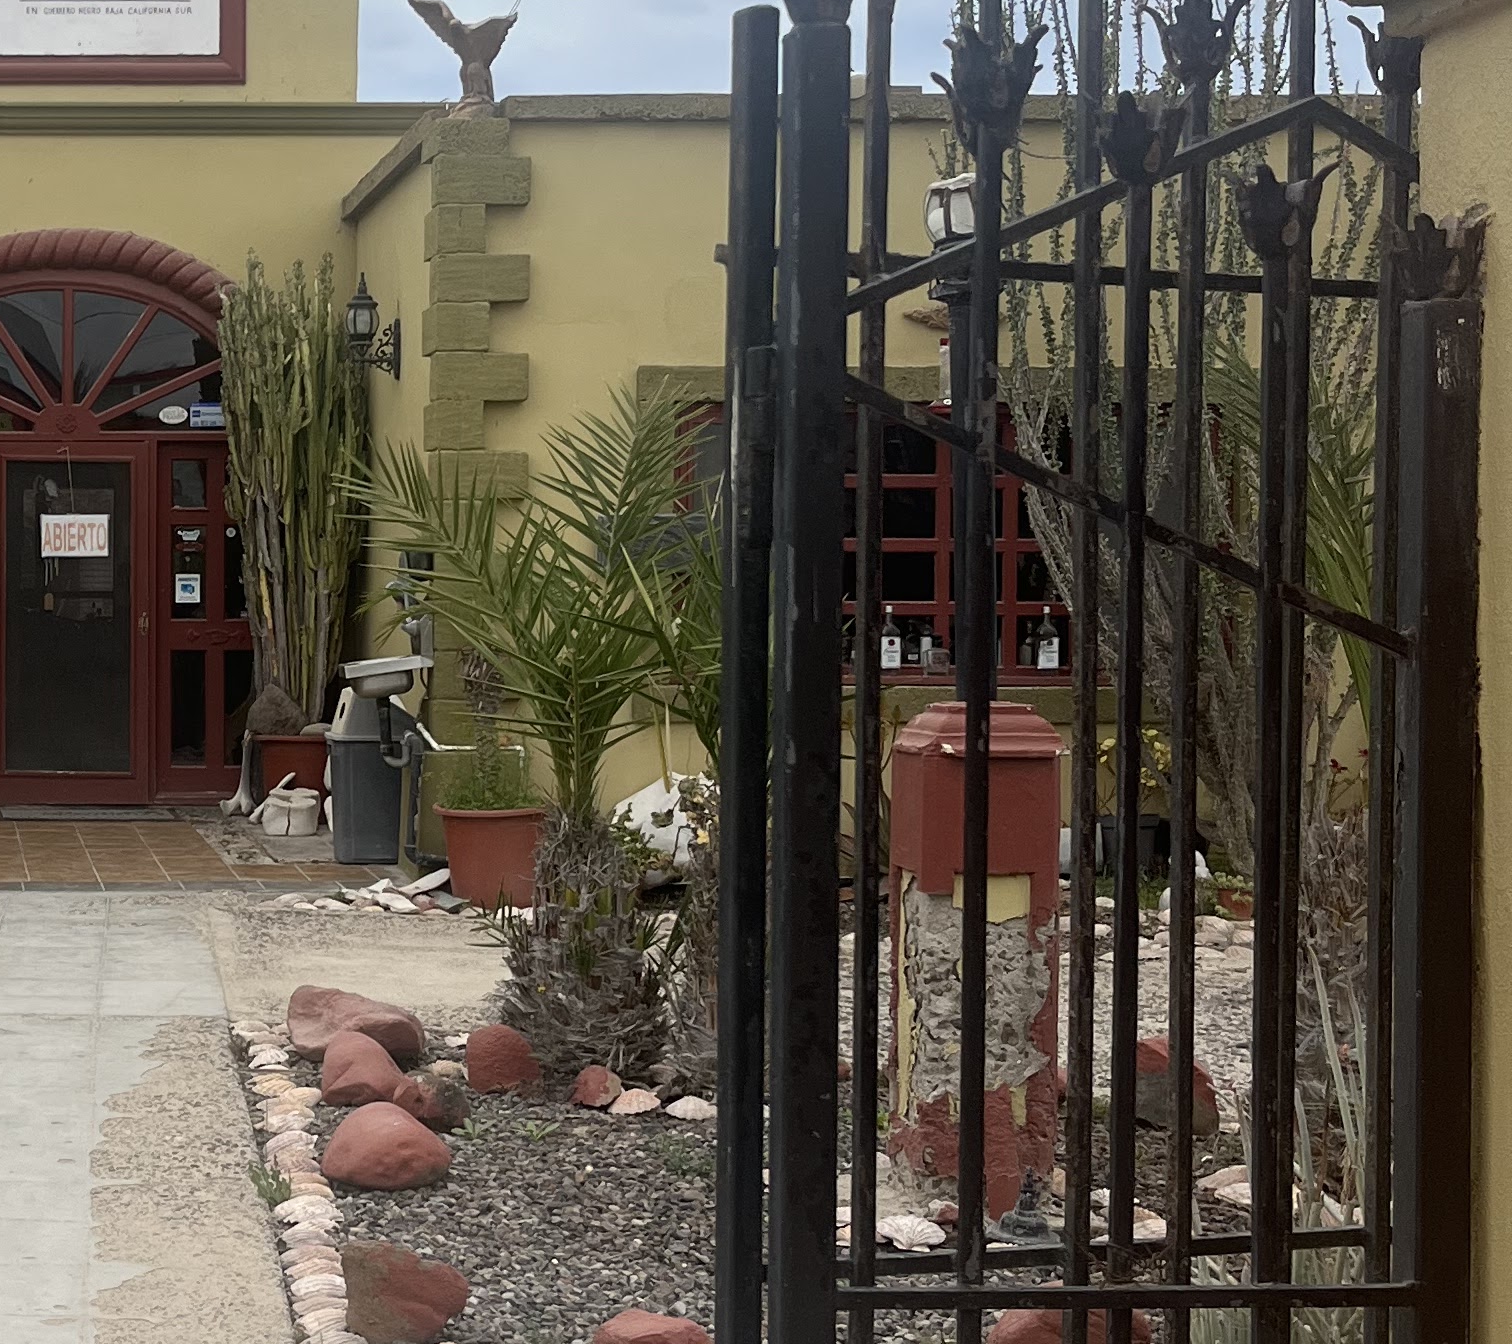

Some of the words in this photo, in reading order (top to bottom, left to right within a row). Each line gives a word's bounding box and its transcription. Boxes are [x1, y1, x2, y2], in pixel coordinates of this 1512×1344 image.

[127, 6, 171, 15] CALIFORNIA
[175, 6, 192, 15] SUR
[42, 522, 107, 552] ABIERTO
